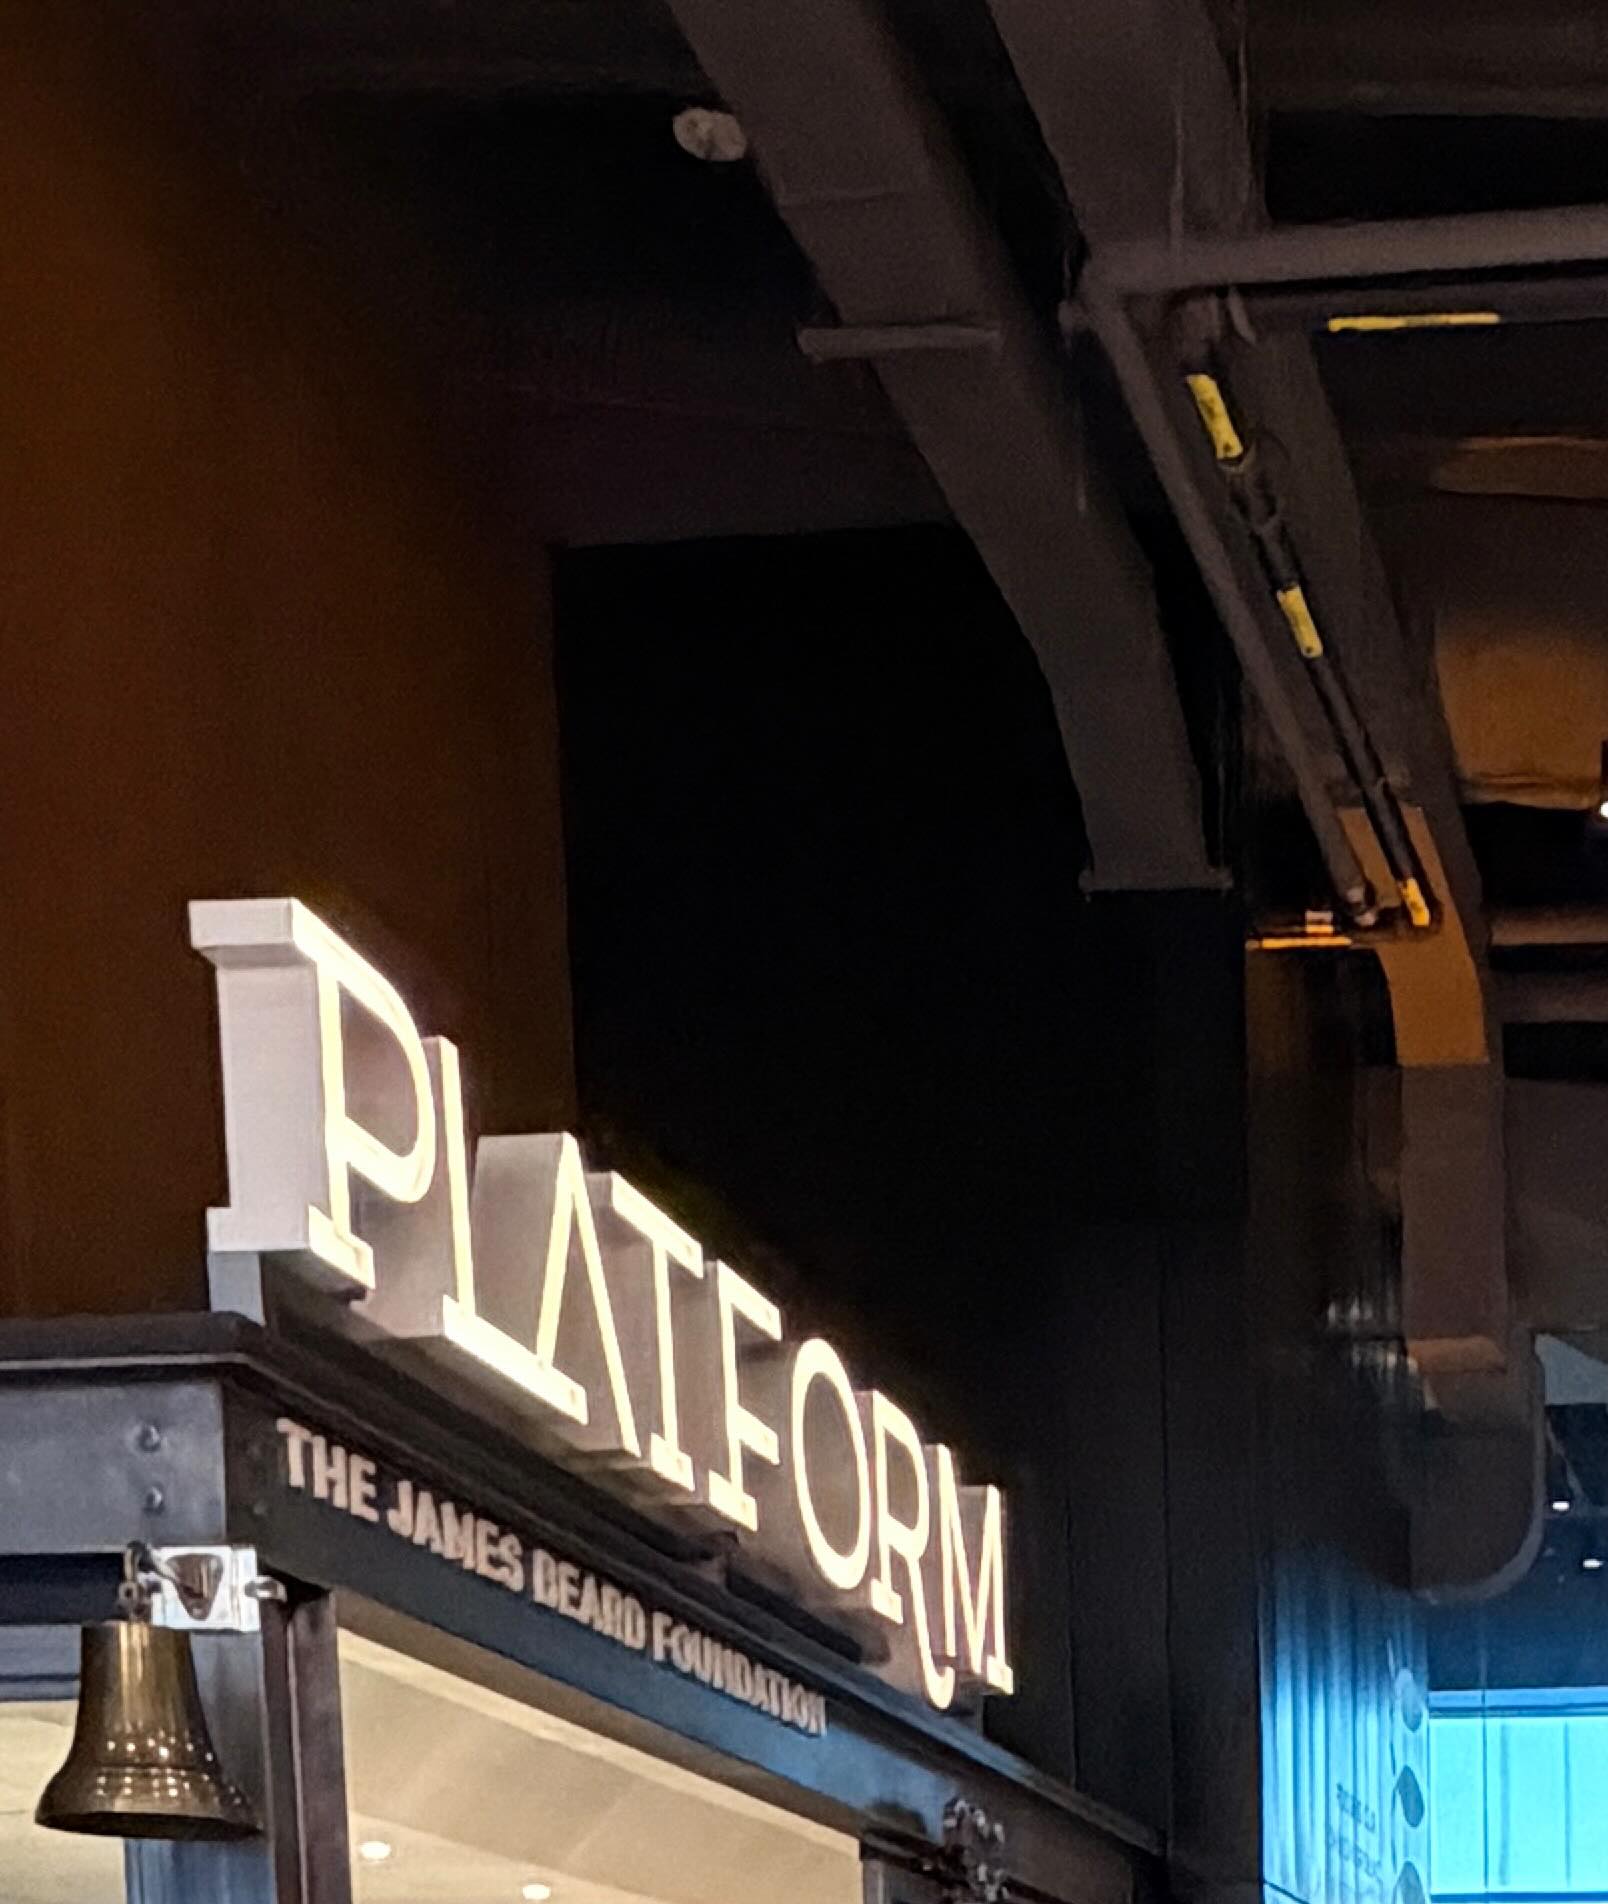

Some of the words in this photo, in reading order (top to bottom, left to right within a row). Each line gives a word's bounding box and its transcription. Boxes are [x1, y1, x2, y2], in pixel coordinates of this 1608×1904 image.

[276, 1418, 378, 1522] THE
[387, 1479, 523, 1593] JAMES
[532, 1548, 647, 1650] BEARD
[652, 1610, 828, 1737] FOUNDATION
[280, 898, 1015, 1708] PLATFORM
